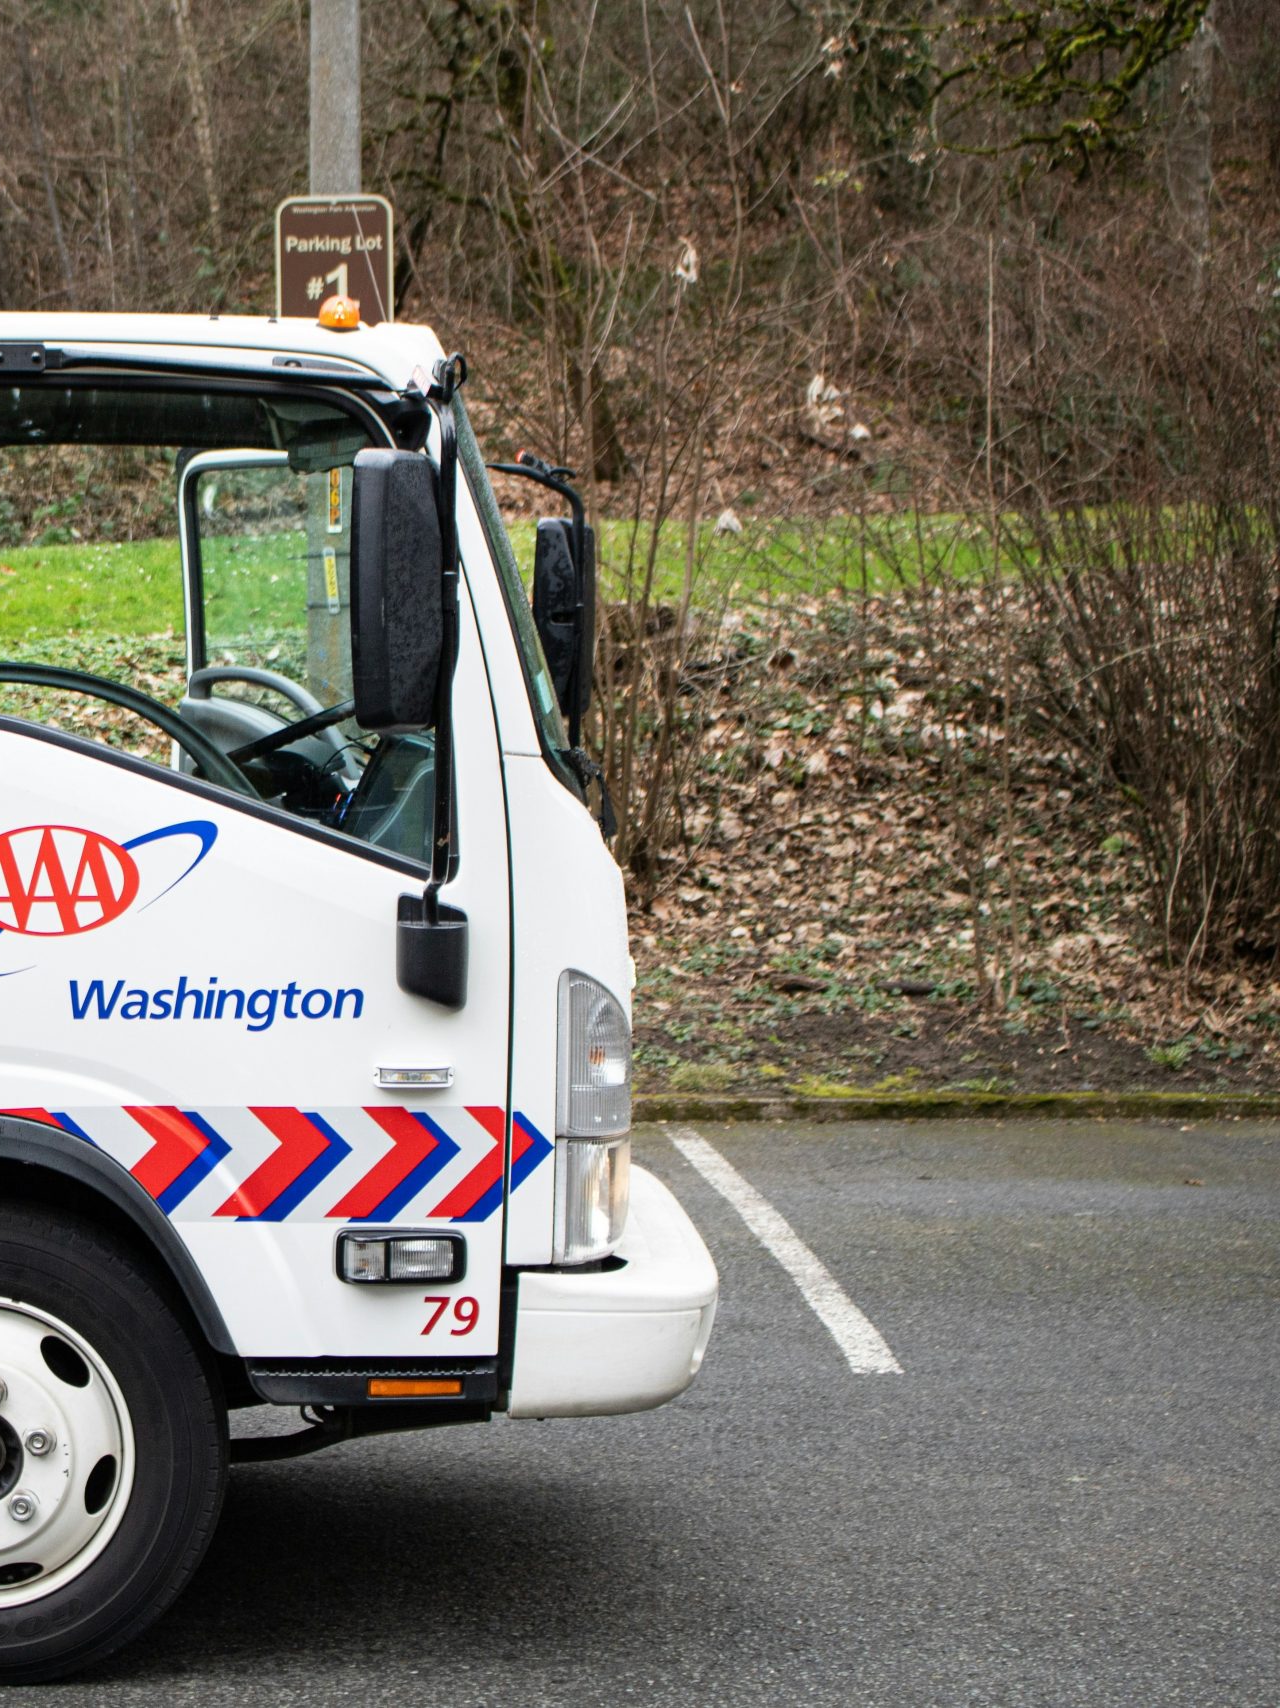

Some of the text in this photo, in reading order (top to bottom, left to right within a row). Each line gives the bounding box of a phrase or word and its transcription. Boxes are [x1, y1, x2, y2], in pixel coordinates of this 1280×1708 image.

[285, 234, 383, 254] Parking Lot
[306, 262, 348, 300] #1
[68, 976, 365, 1032] Washington
[420, 1296, 480, 1337] 79
